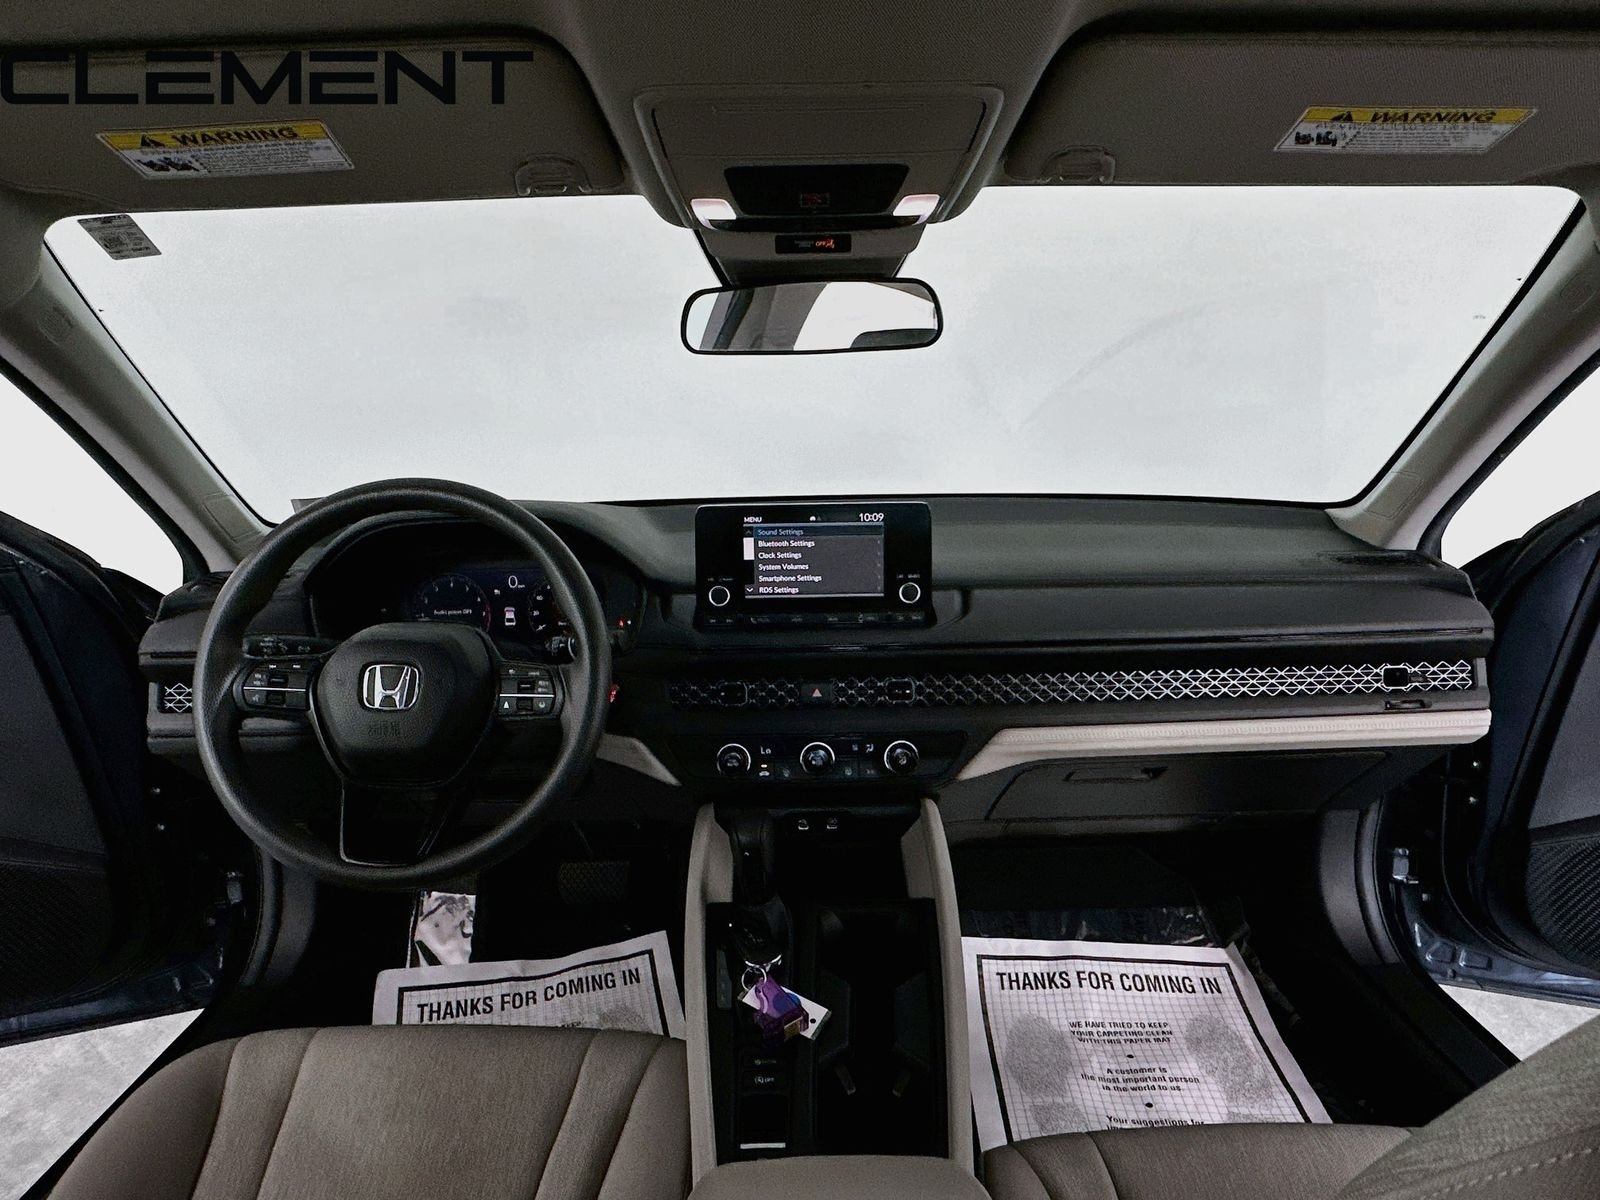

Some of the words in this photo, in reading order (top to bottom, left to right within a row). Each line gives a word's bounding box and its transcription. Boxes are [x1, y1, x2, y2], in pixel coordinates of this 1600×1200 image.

[1370, 111, 1497, 123] WARNING
[171, 127, 299, 147] WARNING
[859, 512, 884, 522] 10:09
[779, 528, 804, 537] Settings
[758, 540, 790, 548] Bluetooth
[790, 540, 815, 548] Settings
[777, 552, 802, 560] Settings
[758, 564, 782, 572] System
[508, 575, 518, 589] 0
[758, 575, 796, 583] Smartphone
[774, 586, 800, 594] Settings
[996, 970, 1072, 991] THANKS
[1076, 970, 1116, 991] FOR
[1120, 973, 1197, 994] COMING
[1200, 977, 1223, 995] IN
[417, 995, 494, 1024] THANKS
[500, 990, 537, 1012] FOR
[544, 972, 617, 1002] COMING
[622, 967, 641, 985] IN
[1069, 1020, 1083, 1029] WE
[1085, 1020, 1106, 1029] HAVE
[1108, 1021, 1133, 1030] TRIED
[1136, 1022, 1146, 1030] TO
[1080, 1073, 1096, 1081] the
[1098, 1076, 1120, 1084] most
[1122, 1076, 1167, 1084] important
[1168, 1076, 1200, 1085] person
[1130, 1084, 1156, 1092] world
[1106, 1115, 1128, 1124] Your
